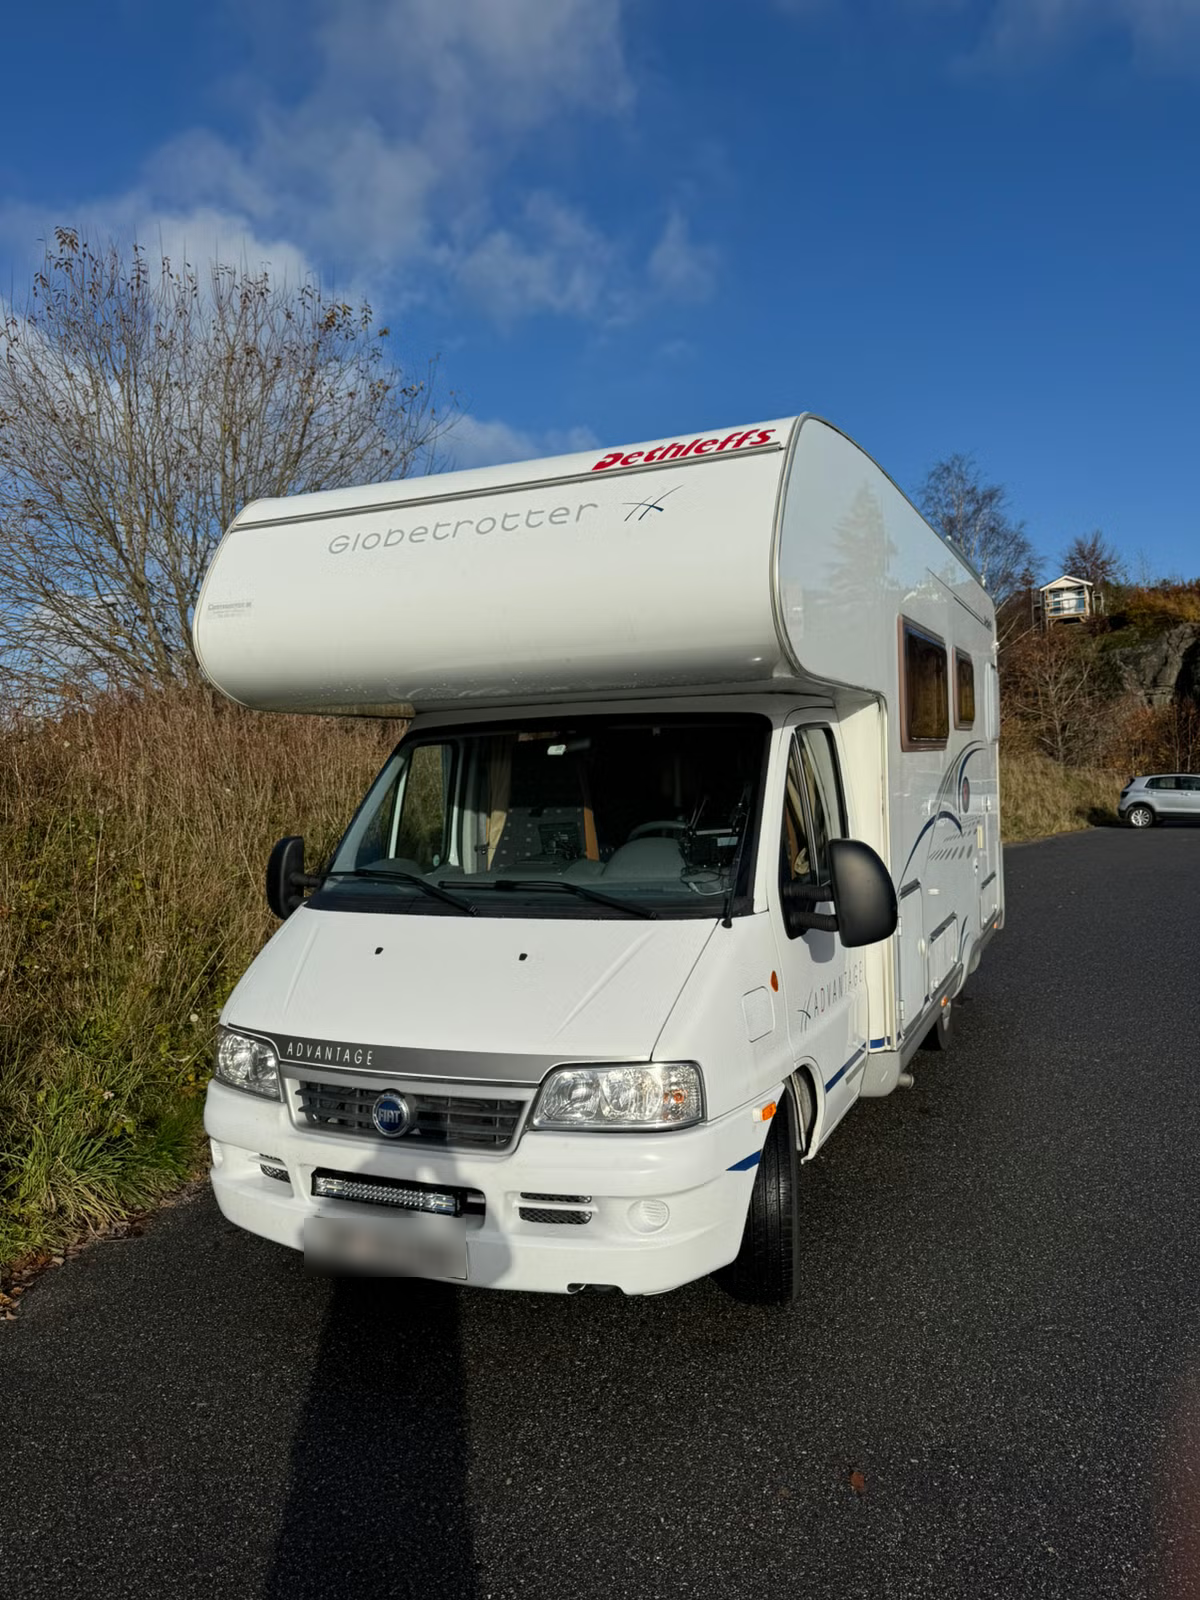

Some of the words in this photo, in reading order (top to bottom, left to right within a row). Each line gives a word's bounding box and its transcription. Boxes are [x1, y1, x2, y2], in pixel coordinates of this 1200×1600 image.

[592, 428, 776, 471] Dethleffs
[328, 503, 598, 555] Globetrotter
[813, 961, 862, 1018] ADVANTAGE
[286, 1042, 373, 1065] ADVANTAGE
[378, 1109, 401, 1123] FIAT
